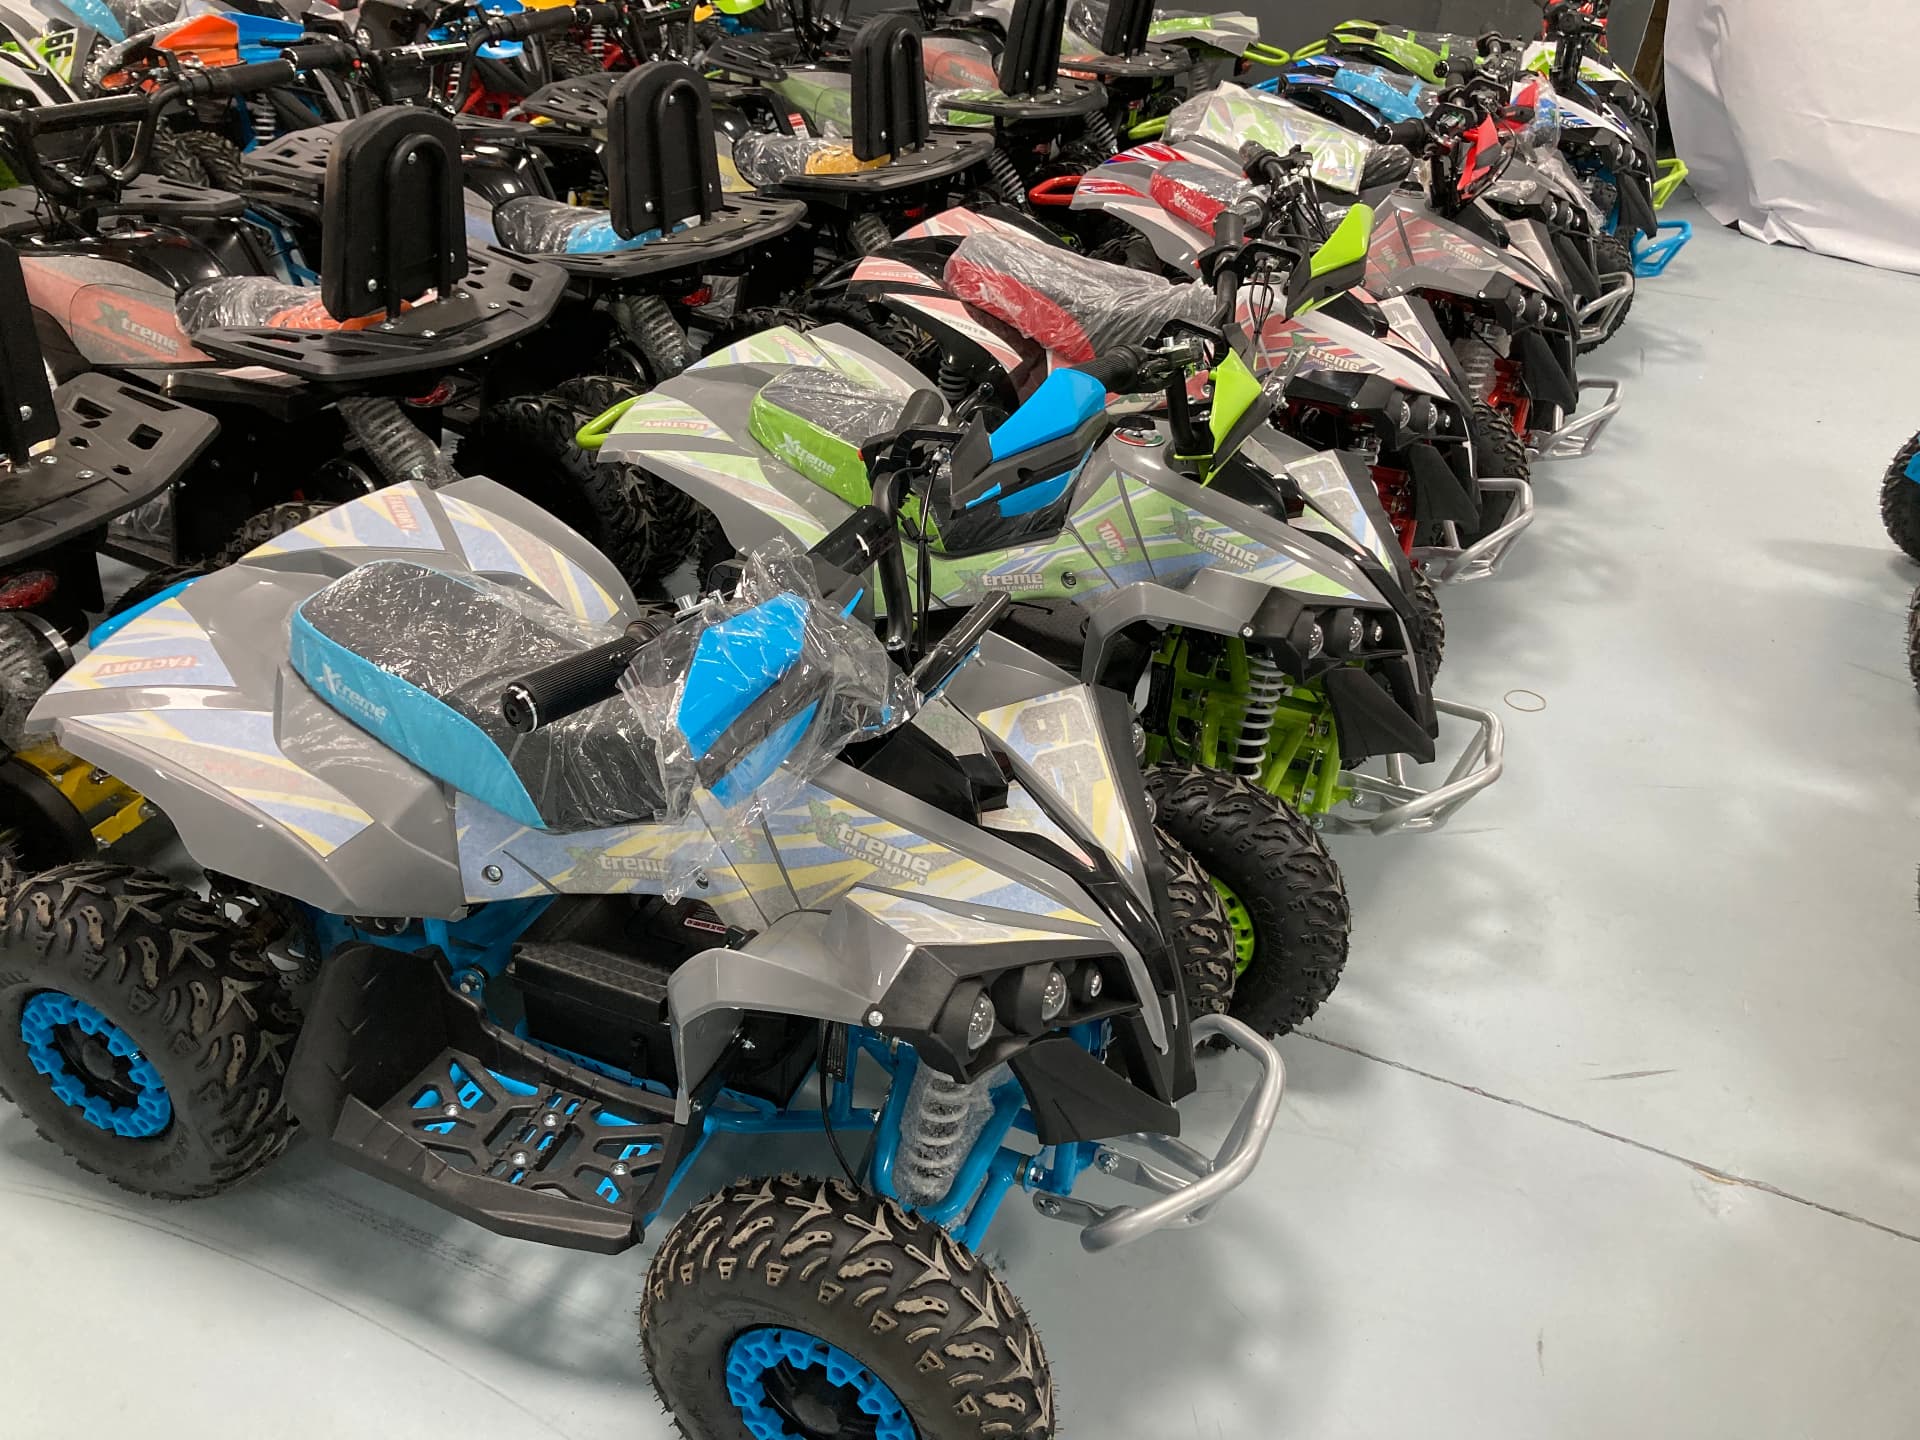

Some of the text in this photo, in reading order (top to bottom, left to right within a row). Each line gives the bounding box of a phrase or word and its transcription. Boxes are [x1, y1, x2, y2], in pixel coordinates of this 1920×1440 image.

[91, 301, 179, 352] Xtreme
[645, 420, 706, 431] FACTORY
[777, 431, 836, 475] Xtreme
[1098, 521, 1128, 561] 100%
[1160, 507, 1259, 566] Xtreme
[954, 568, 1043, 593] Xtreme
[98, 655, 194, 675] FACTORY
[316, 661, 389, 721] Xtreme
[796, 797, 932, 876] Xtreme
[840, 844, 930, 887] motosport
